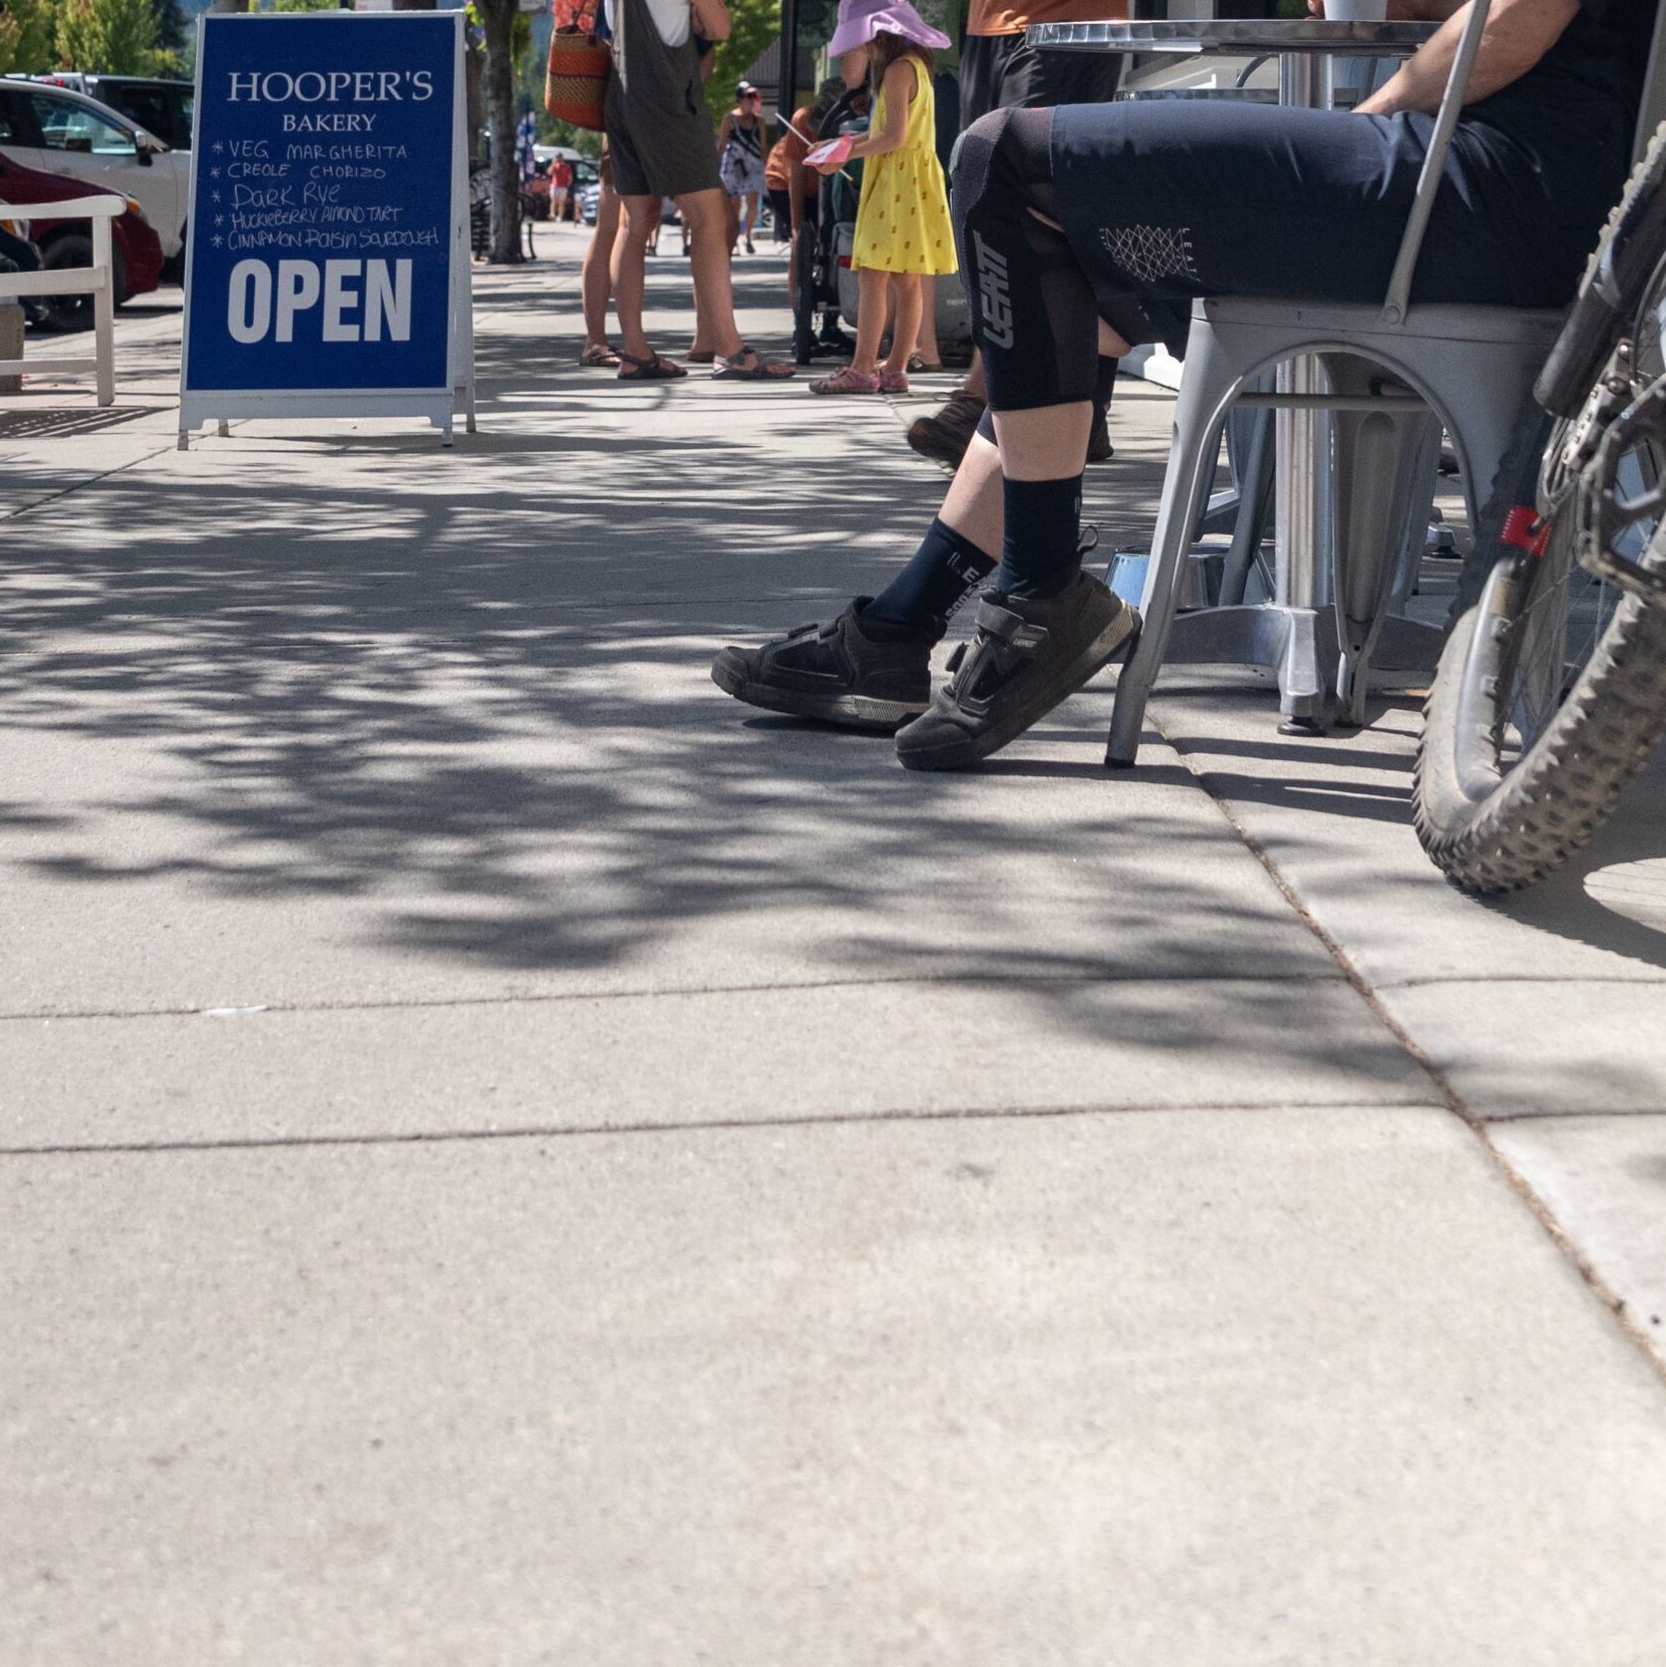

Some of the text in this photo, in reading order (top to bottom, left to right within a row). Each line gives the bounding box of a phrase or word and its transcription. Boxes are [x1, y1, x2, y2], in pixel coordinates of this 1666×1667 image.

[227, 71, 433, 102] HOOPER'S
[283, 114, 377, 132] BAKERY
[229, 140, 269, 159] VEG
[228, 162, 386, 179] CREOLE CHORIZO
[227, 258, 413, 344] OPEN
